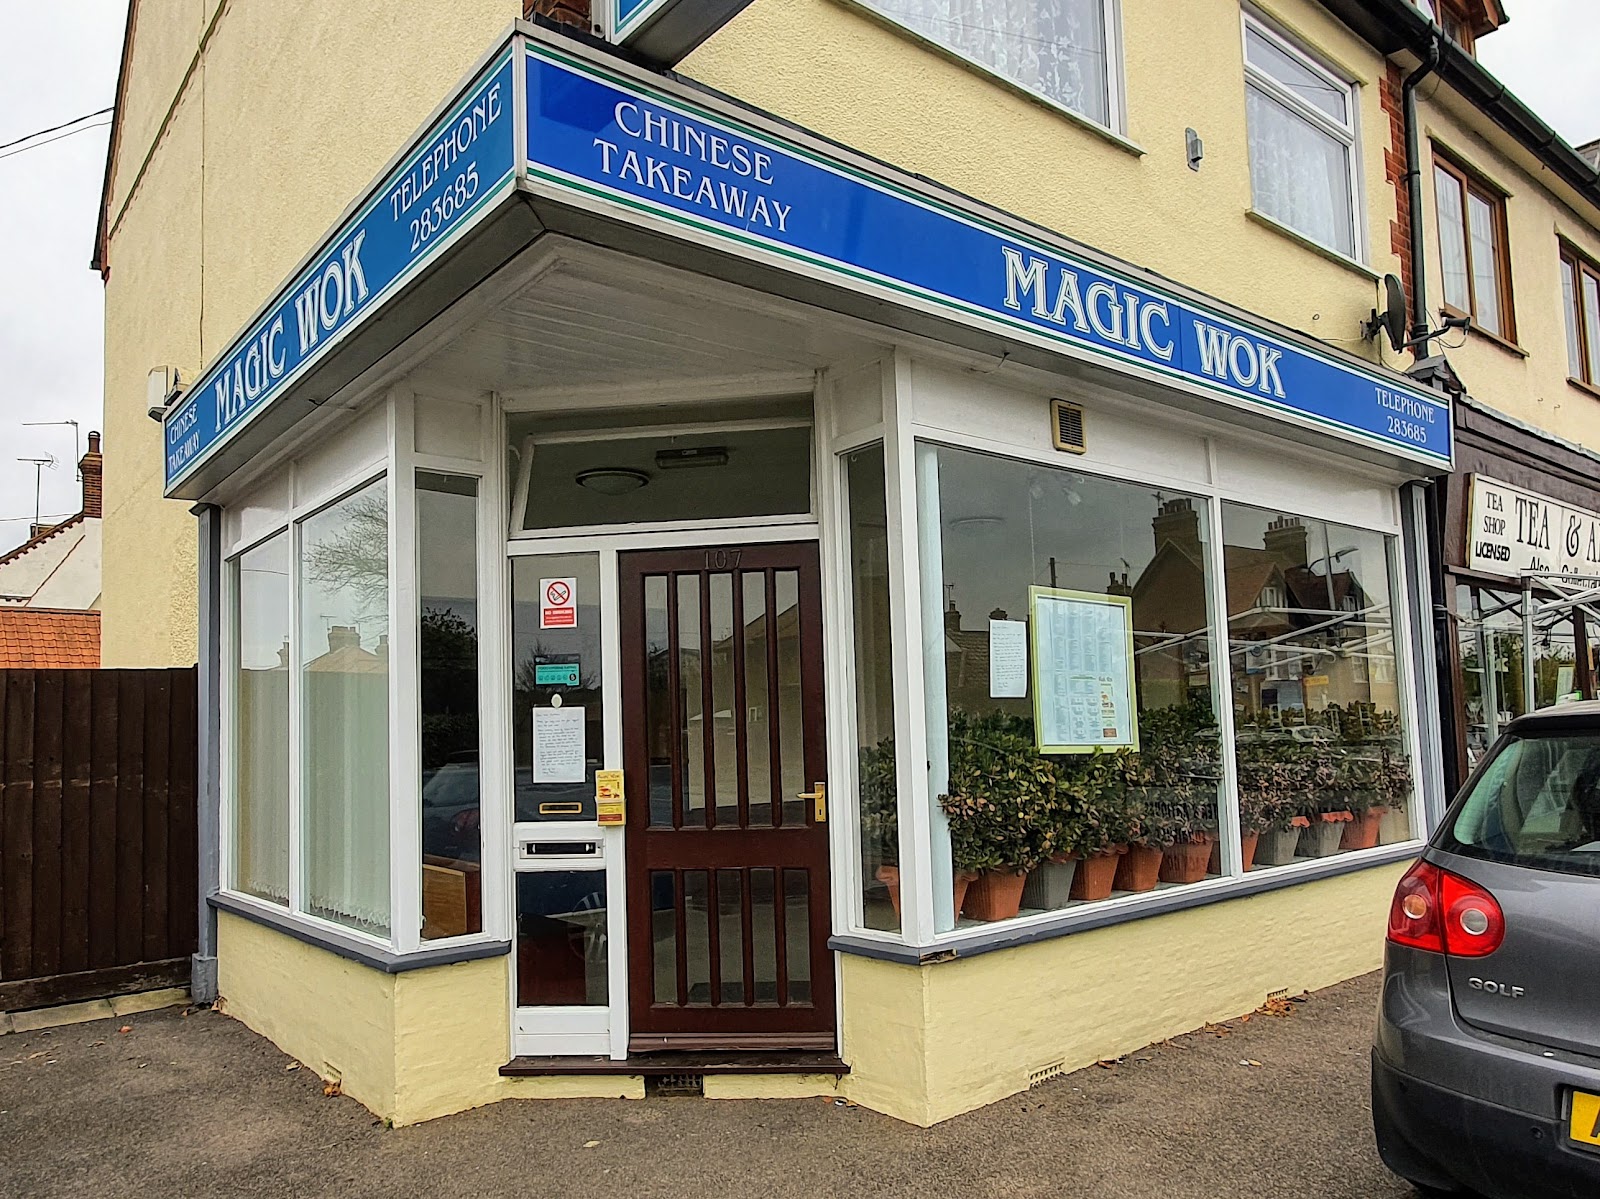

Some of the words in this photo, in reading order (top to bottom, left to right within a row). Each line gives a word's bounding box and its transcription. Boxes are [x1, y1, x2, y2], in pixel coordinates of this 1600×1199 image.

[389, 81, 502, 222] TELEPHONE
[614, 101, 774, 185] CHINESE
[409, 160, 480, 254] 283685
[593, 138, 792, 233] TAKEAWAY
[214, 312, 288, 433] MAGIC
[294, 228, 370, 354] WOK
[1001, 245, 1175, 362] MAGIC
[1193, 319, 1286, 399] WOK
[170, 403, 198, 445] CHINESE
[1374, 387, 1435, 424] TELEPHONE
[168, 428, 200, 474] TAKEAWAY
[1387, 415, 1427, 443] 283685
[1486, 491, 1503, 512] TEA
[1484, 515, 1506, 536] SHOP
[1515, 495, 1550, 550] TEA
[1566, 515, 1582, 557] &
[1586, 521, 1600, 563] A
[704, 549, 741, 570] 107
[1475, 541, 1511, 562] LICENSED
[1468, 977, 1524, 998] GOLF
